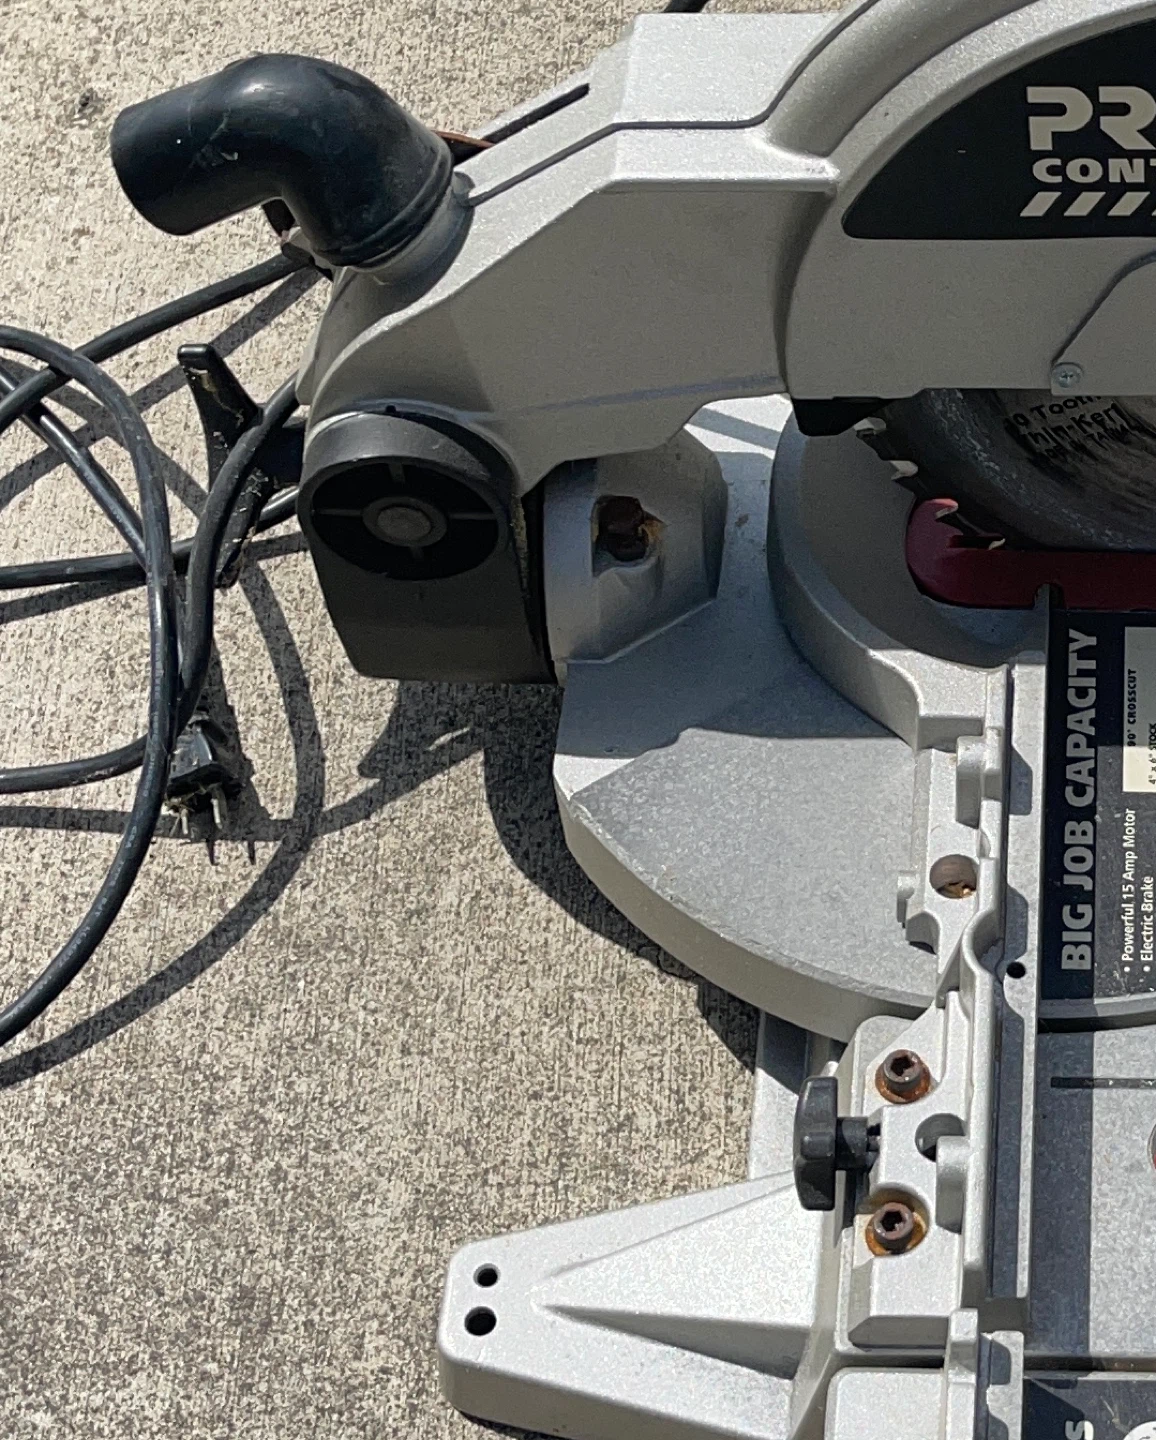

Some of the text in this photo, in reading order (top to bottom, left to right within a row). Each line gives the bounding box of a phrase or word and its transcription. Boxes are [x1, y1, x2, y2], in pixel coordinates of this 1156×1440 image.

[1127, 669, 1136, 724] CROSSCUT
[1149, 723, 1156, 750] STOCK
[1061, 629, 1097, 970] BIG JOB CAPACITY
[1122, 809, 1138, 961] Powerful 15 Amp Motor
[1141, 877, 1154, 961] Electric Brake
